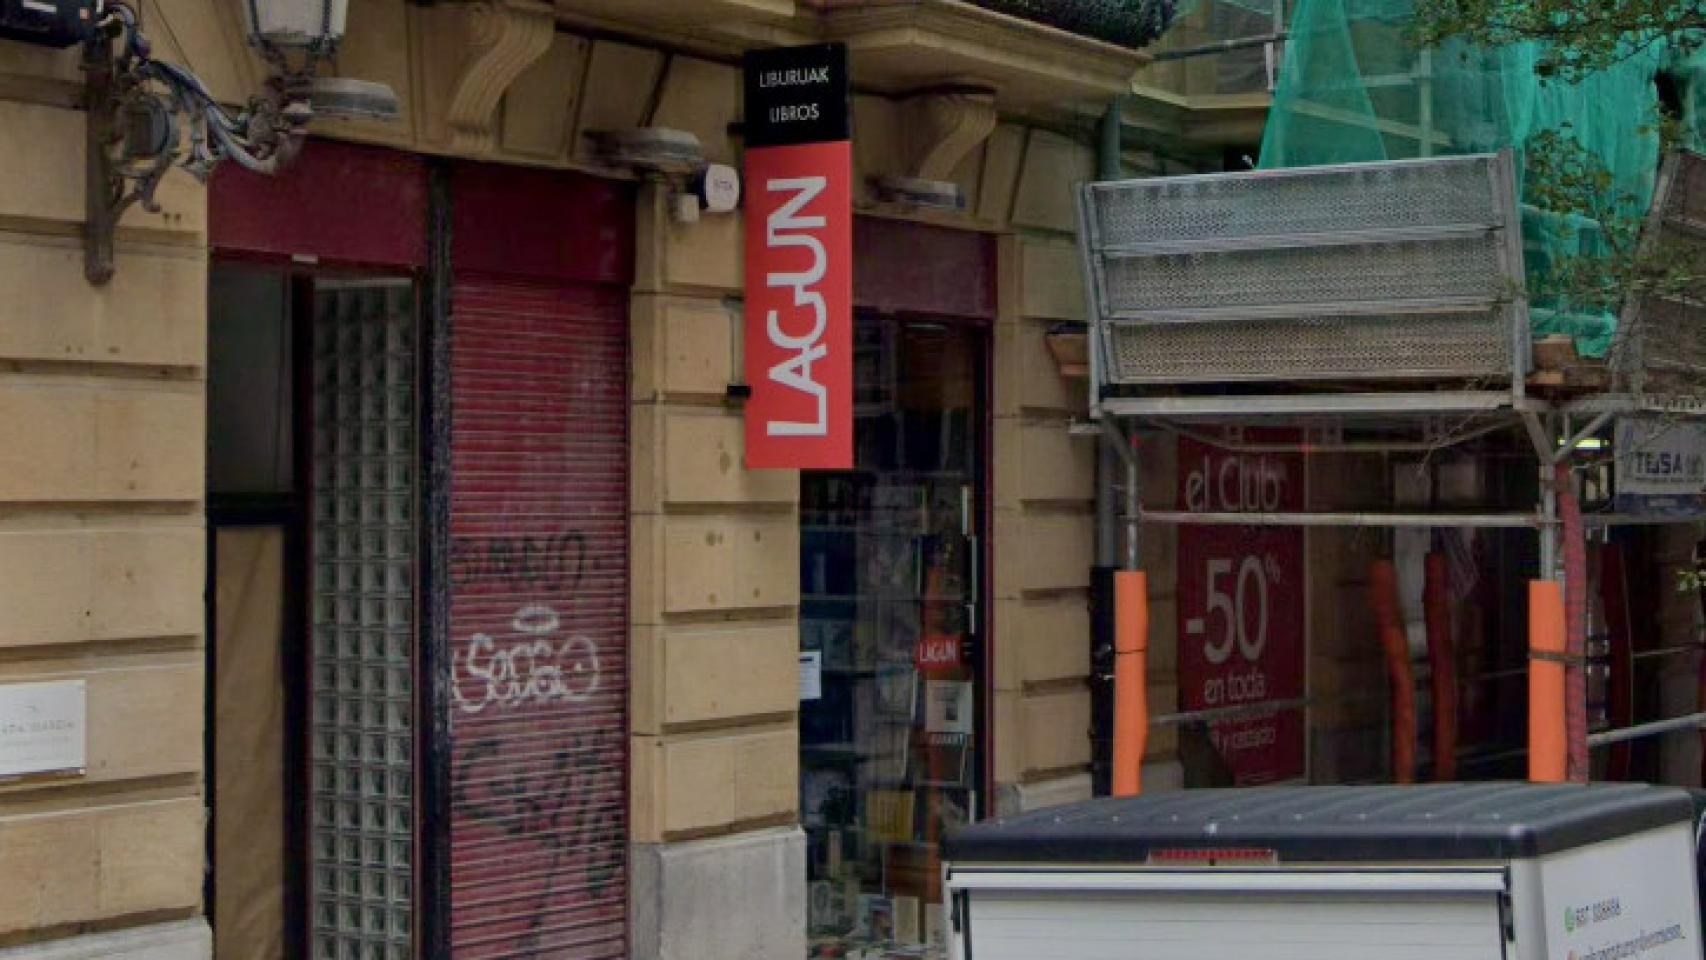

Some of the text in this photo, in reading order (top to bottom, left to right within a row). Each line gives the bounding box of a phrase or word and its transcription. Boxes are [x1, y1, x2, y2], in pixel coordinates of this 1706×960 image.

[759, 66, 830, 88] LIBURUAK
[768, 103, 820, 123] LIBROS
[766, 176, 827, 436] LAGUN
[1185, 454, 1283, 513] el Club
[918, 641, 957, 662] LAGUN
[1204, 667, 1266, 704] en toda
